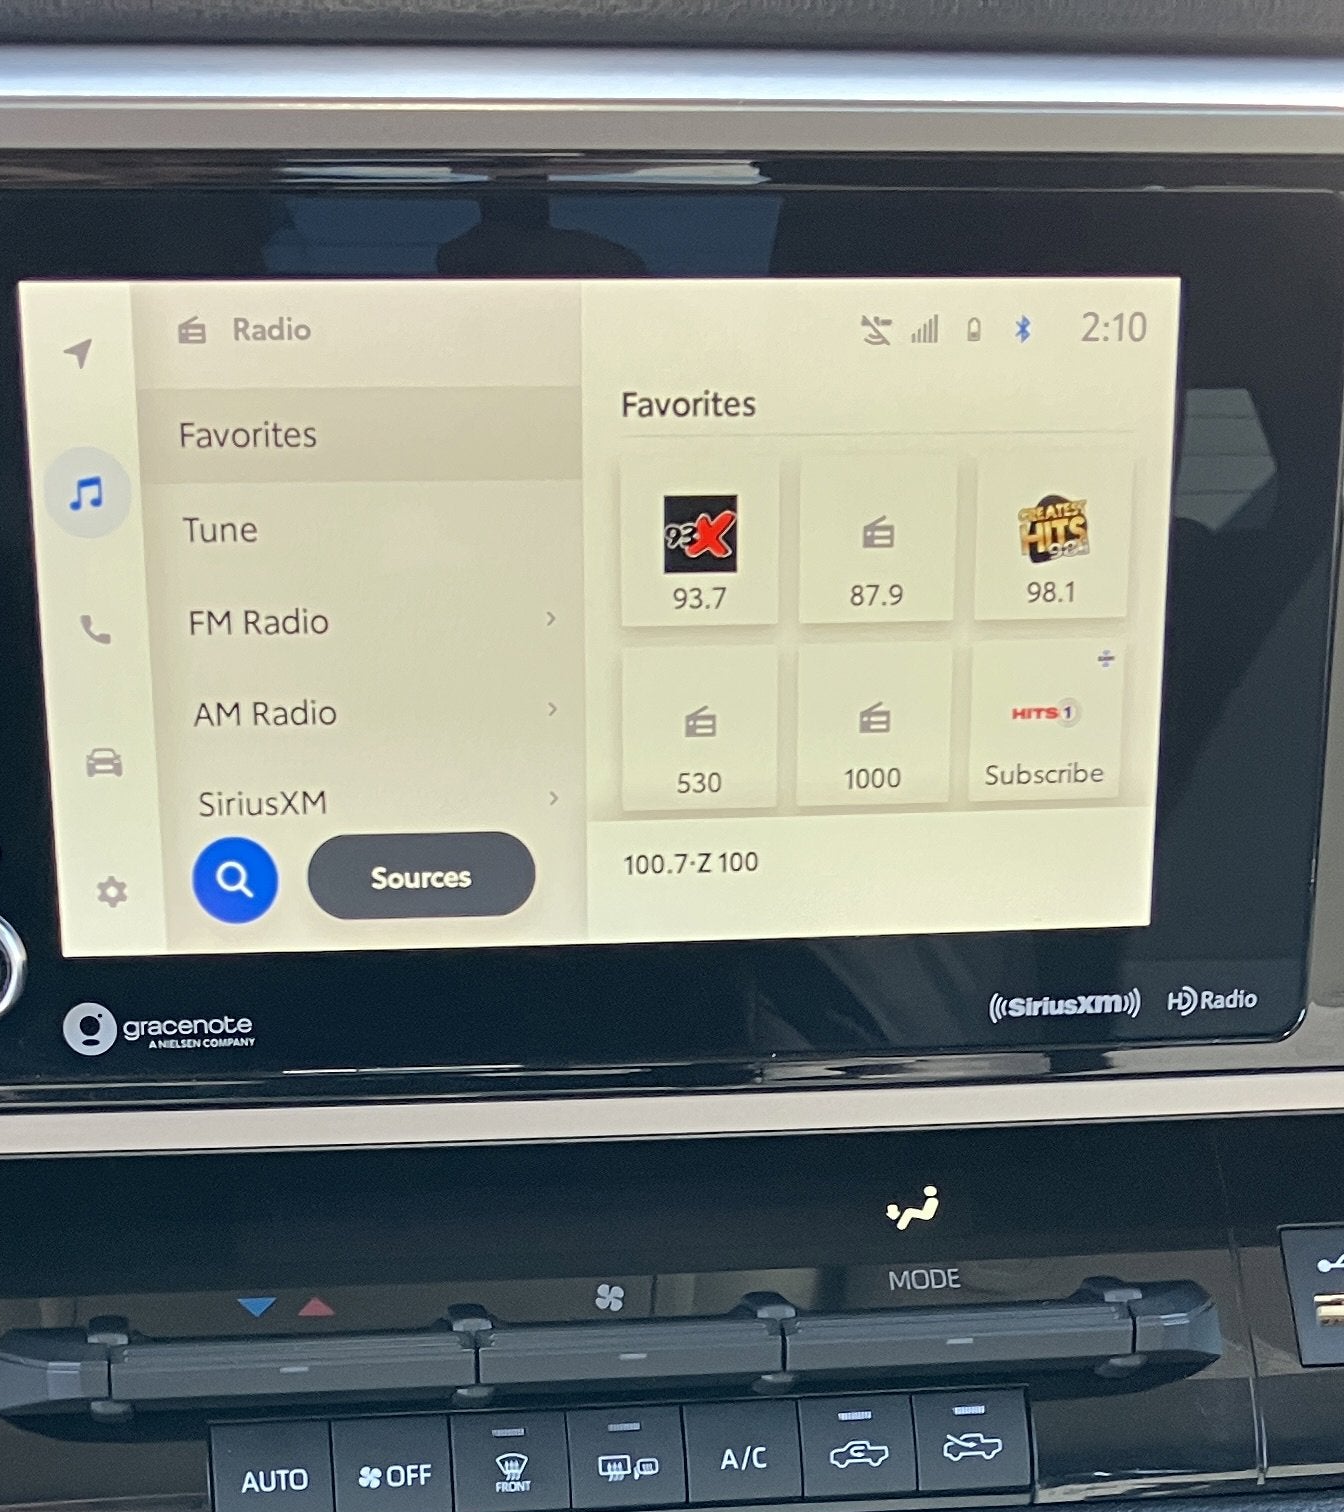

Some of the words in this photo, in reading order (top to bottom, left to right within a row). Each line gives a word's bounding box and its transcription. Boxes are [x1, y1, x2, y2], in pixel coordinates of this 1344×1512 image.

[233, 318, 312, 343] Radio
[1081, 311, 1148, 343] 2:10
[622, 390, 756, 418] Favorites
[179, 421, 317, 449] Favorites
[183, 517, 258, 544] Tune
[1019, 515, 1088, 556] HITS
[673, 586, 727, 611] 93.7
[850, 583, 904, 607] 87.9
[1027, 580, 1075, 604] 98.1
[190, 610, 232, 635] FM
[244, 608, 330, 635] Radio
[193, 702, 241, 726] AM
[253, 700, 337, 726] Radio
[1011, 706, 1060, 720] HITS
[676, 771, 722, 794] 530
[844, 768, 902, 790] 1000
[984, 762, 1104, 787] Subscribe
[199, 789, 327, 818] SiriusXM
[719, 851, 758, 873] 100
[371, 865, 472, 890] Sources
[1200, 988, 1258, 1010] Radio
[122, 1015, 253, 1041] gracenote
[148, 1039, 158, 1049] A
[158, 1038, 201, 1049] NIELSEN
[202, 1037, 256, 1048] COMPANY
[888, 1266, 960, 1292] MODE
[720, 1445, 768, 1472] A/C
[241, 1467, 309, 1494] AUTO
[385, 1463, 432, 1489] OFF
[494, 1480, 531, 1493] FRONT
